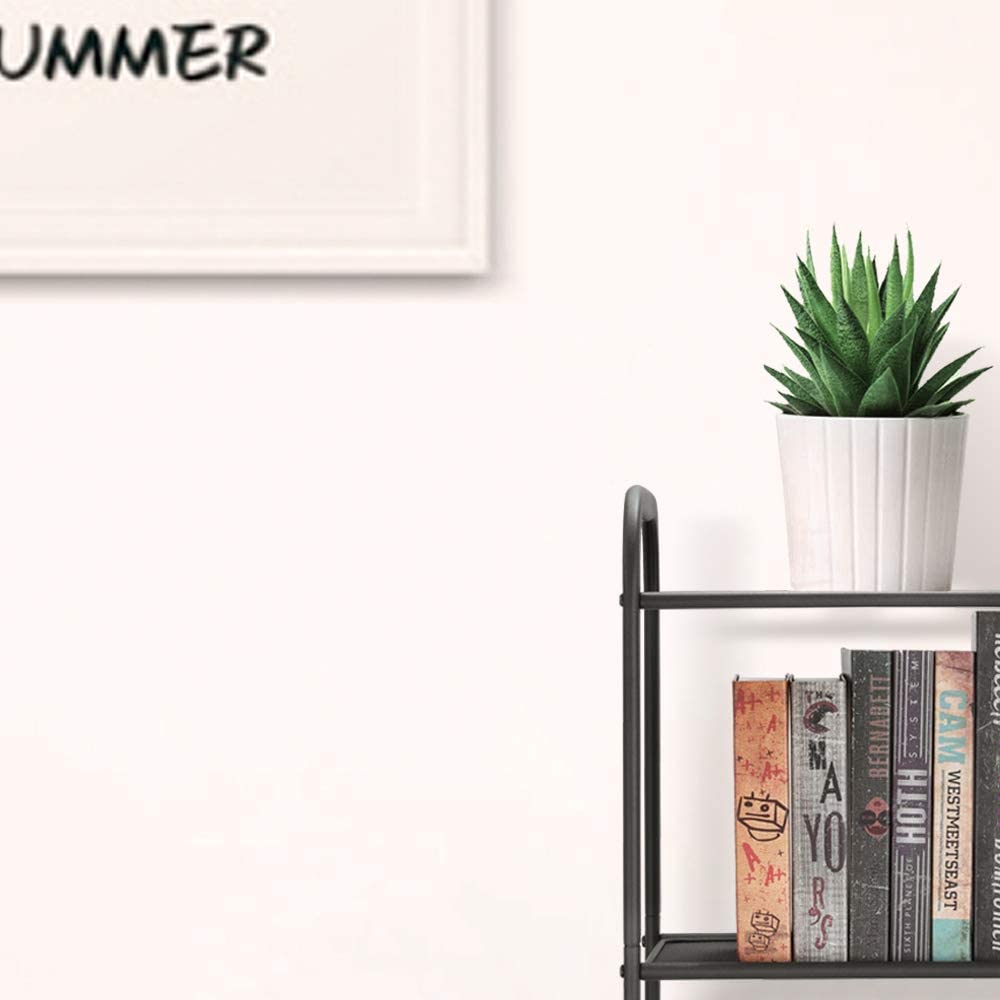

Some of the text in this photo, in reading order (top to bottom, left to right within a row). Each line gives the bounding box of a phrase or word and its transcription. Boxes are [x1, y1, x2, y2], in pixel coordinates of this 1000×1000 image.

[909, 660, 920, 759] SYSTEM
[938, 690, 968, 765] CAM
[896, 769, 927, 844] HOTH
[903, 922, 912, 953] SIXTH
